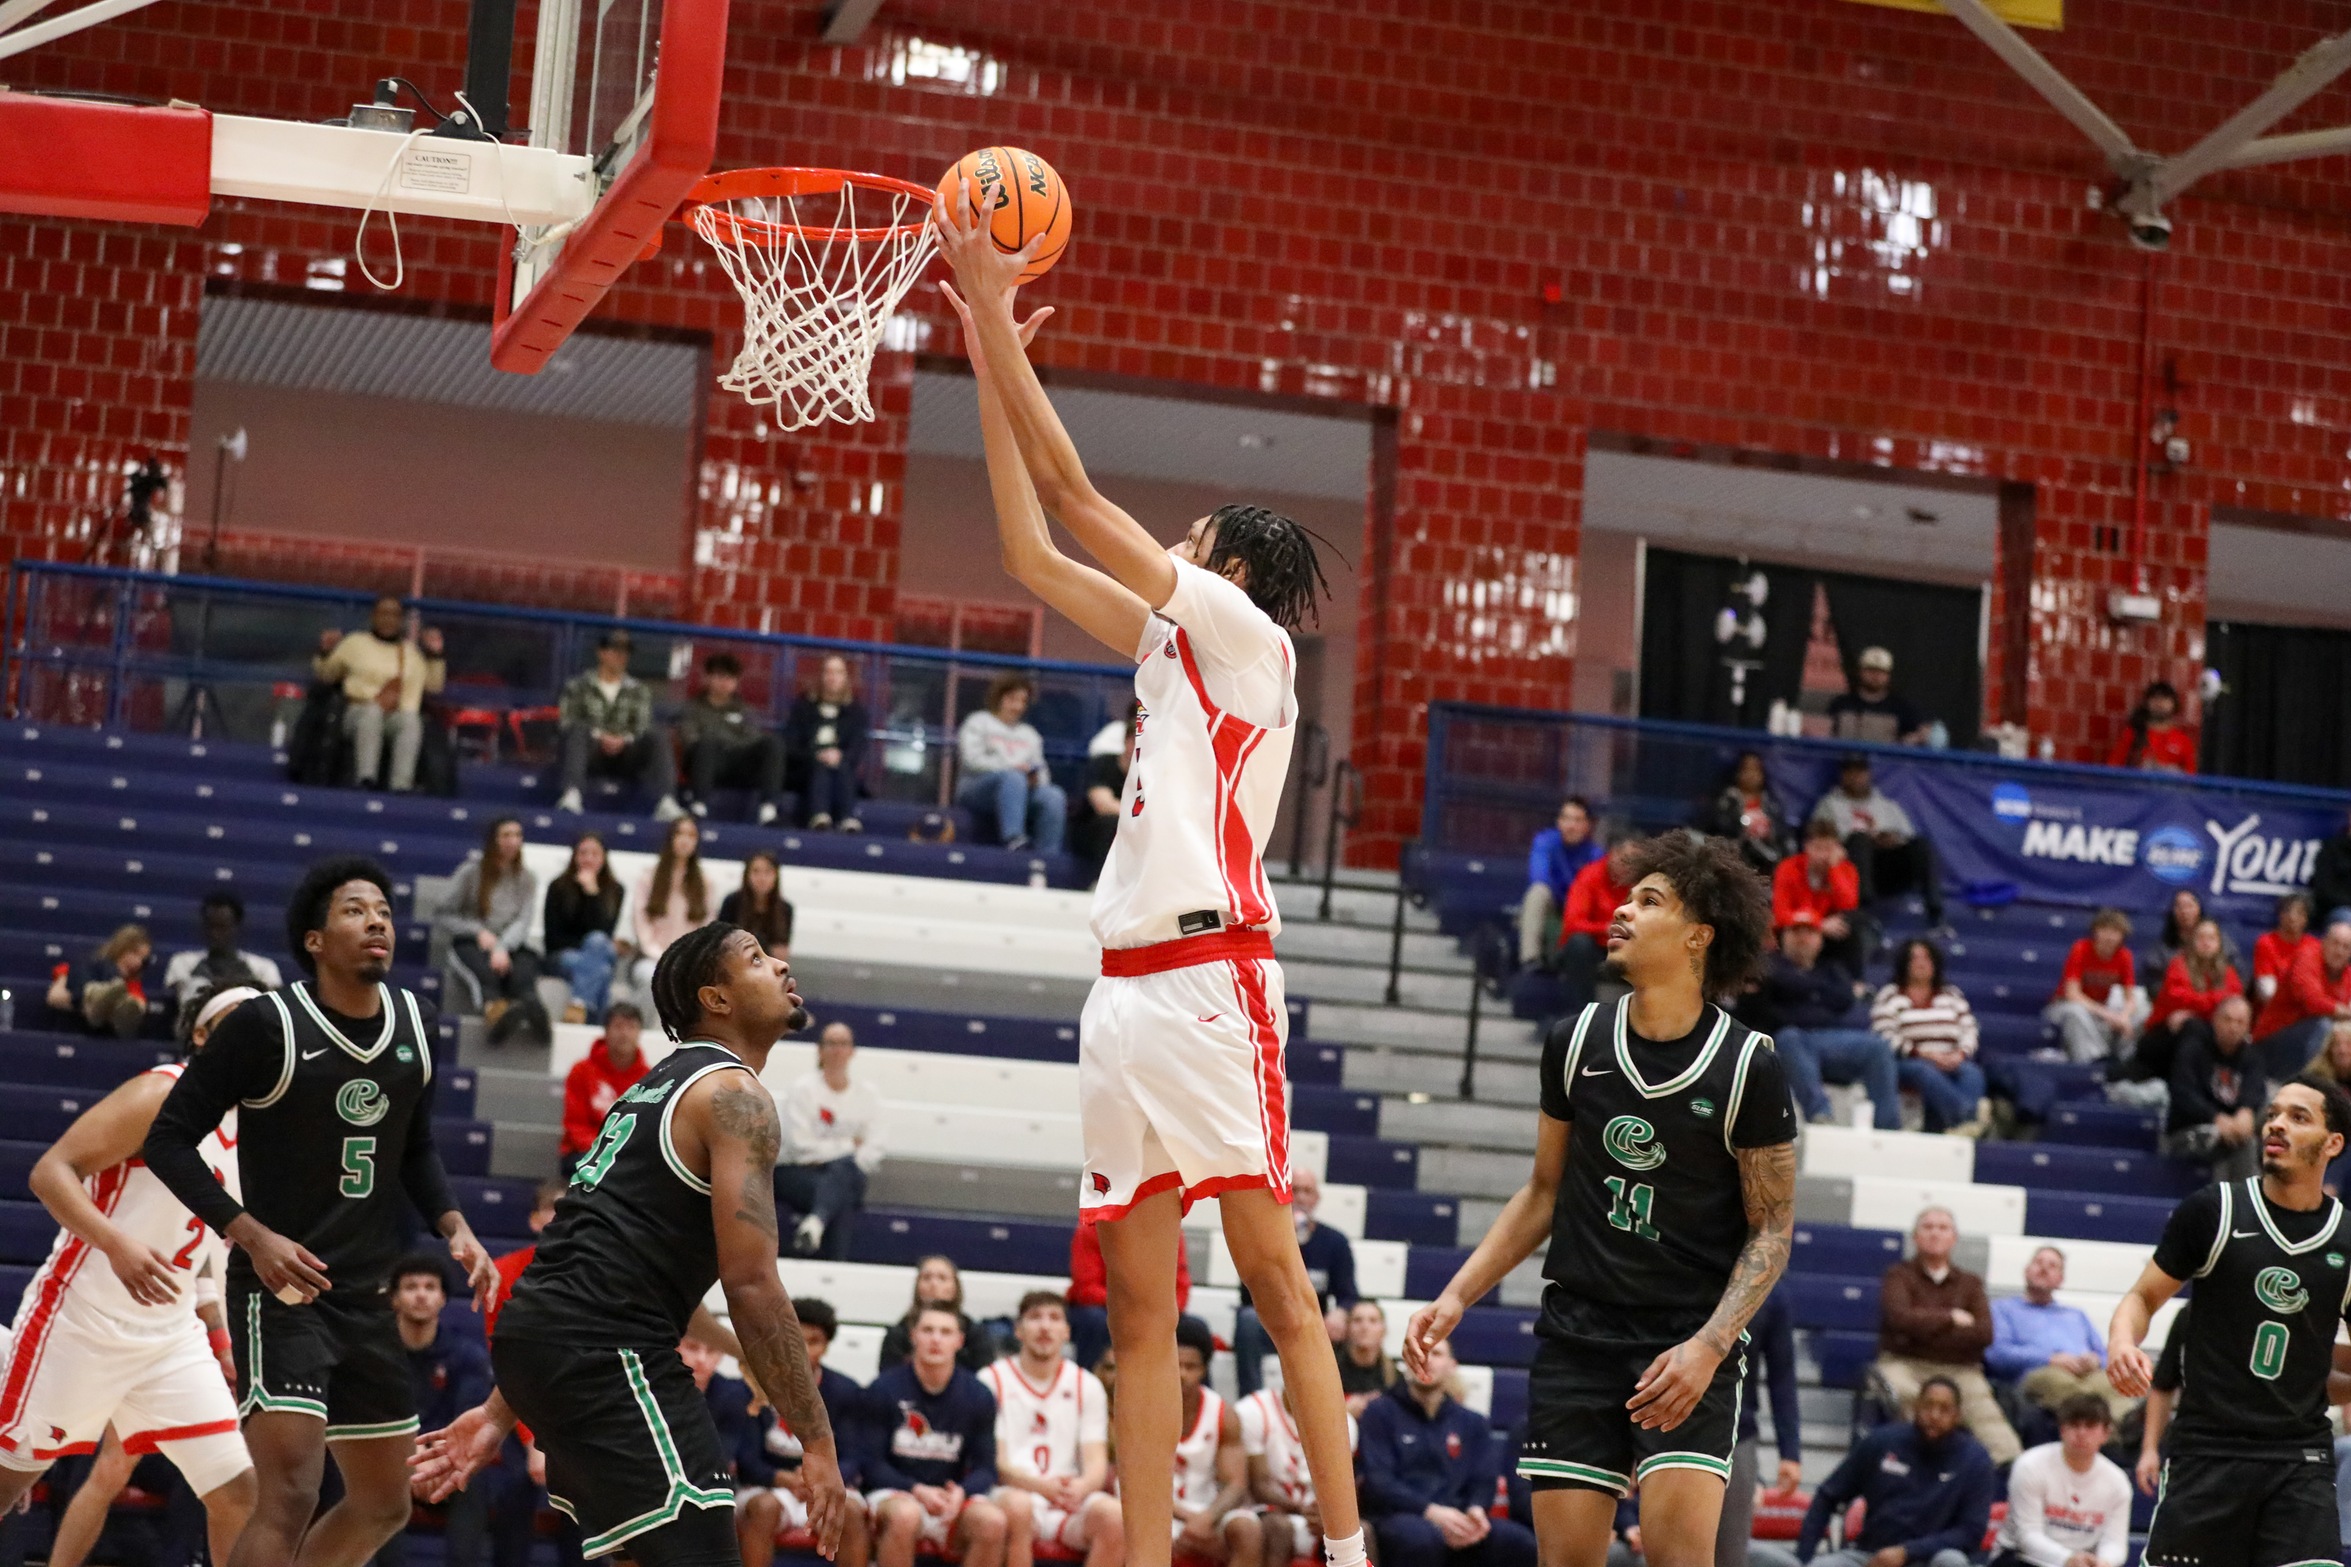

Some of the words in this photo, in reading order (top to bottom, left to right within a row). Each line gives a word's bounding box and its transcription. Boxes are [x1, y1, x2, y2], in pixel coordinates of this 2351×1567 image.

[1020, 150, 1047, 198] NCA
[2021, 820, 2139, 867] MAKE
[339, 1136, 377, 1198] 5
[1603, 1175, 1661, 1242] 11
[172, 1216, 205, 1270] 2
[2249, 1320, 2290, 1380] 0
